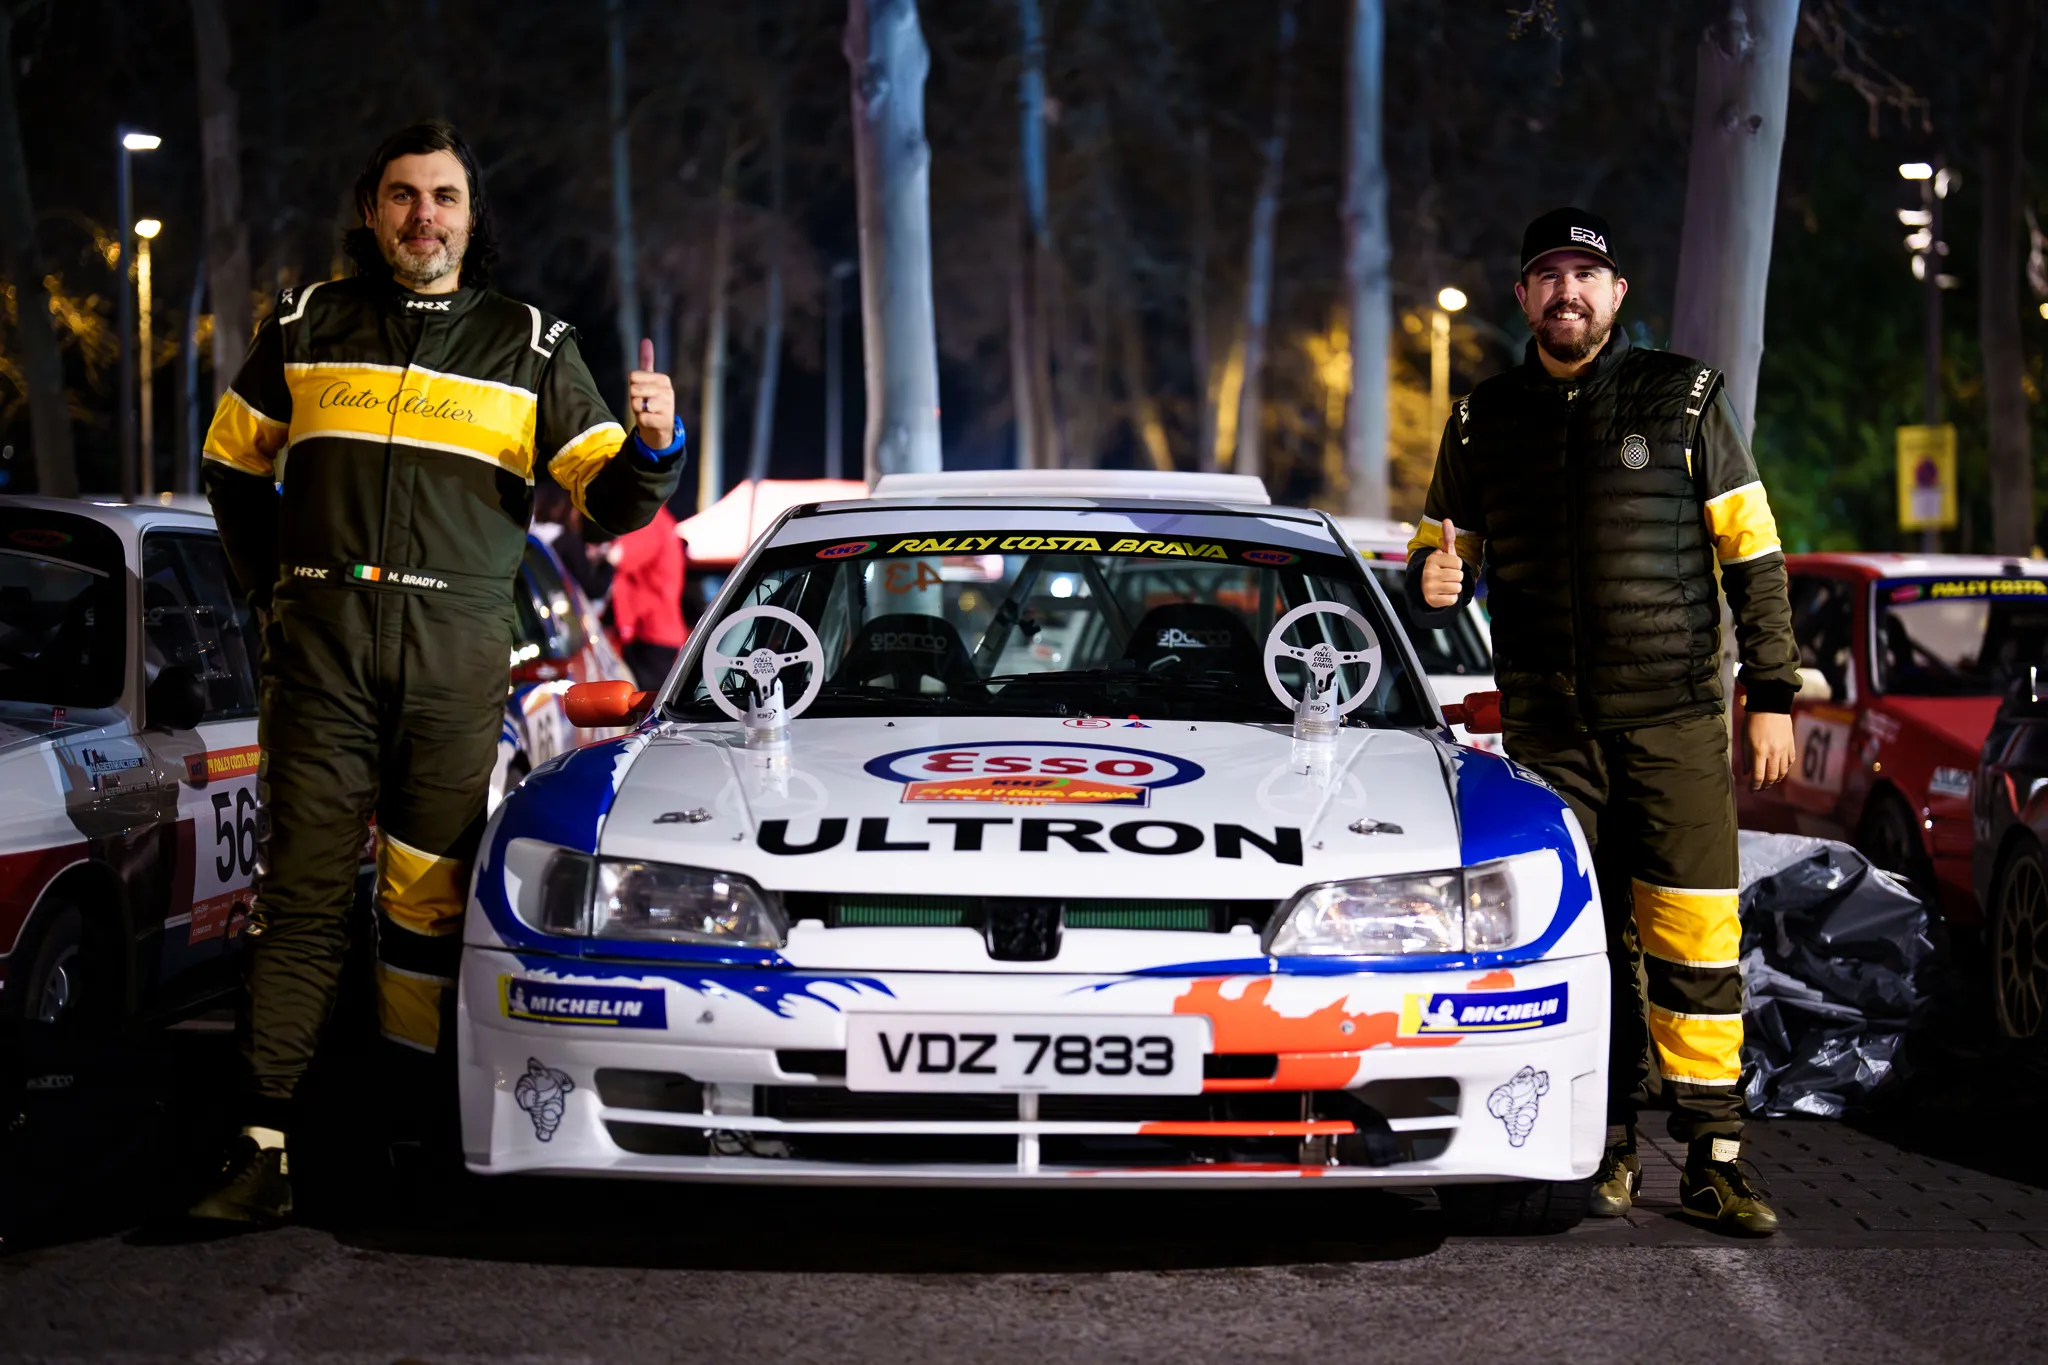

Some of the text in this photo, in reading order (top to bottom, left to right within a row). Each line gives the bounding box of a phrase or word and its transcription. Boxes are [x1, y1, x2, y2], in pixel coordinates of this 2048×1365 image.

[1570, 226, 1607, 250] ERA
[406, 300, 452, 311] HRX
[1690, 368, 1712, 398] HRX
[319, 381, 478, 424] Auto Atelier
[886, 536, 1229, 559] RALLY COSTA BRAVA
[293, 566, 329, 579] HRX
[387, 571, 400, 582] M.
[402, 574, 437, 588] BRADY
[870, 632, 948, 653] sparco
[1802, 724, 1832, 785] 61
[211, 786, 256, 883] 56
[757, 817, 1304, 867] ULTRON
[530, 996, 643, 1017] MICHELIN
[1459, 998, 1560, 1023] MICHELIN
[878, 1032, 1175, 1076] VDZ 7833
